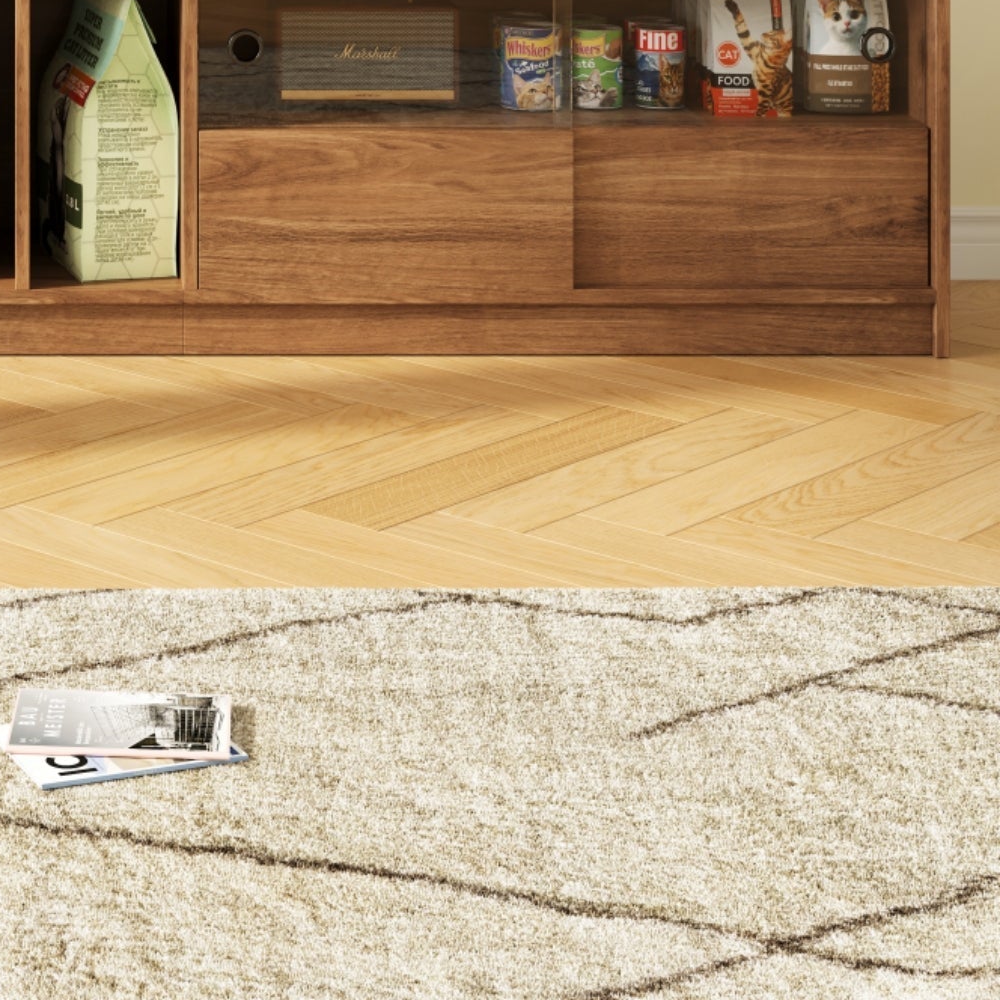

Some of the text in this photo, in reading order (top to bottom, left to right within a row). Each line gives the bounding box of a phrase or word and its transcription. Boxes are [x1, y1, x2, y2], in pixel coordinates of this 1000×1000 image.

[334, 43, 400, 59] Marshall
[506, 39, 552, 57] Whiskers
[719, 49, 739, 60] CAT
[717, 76, 750, 86] FOOD
